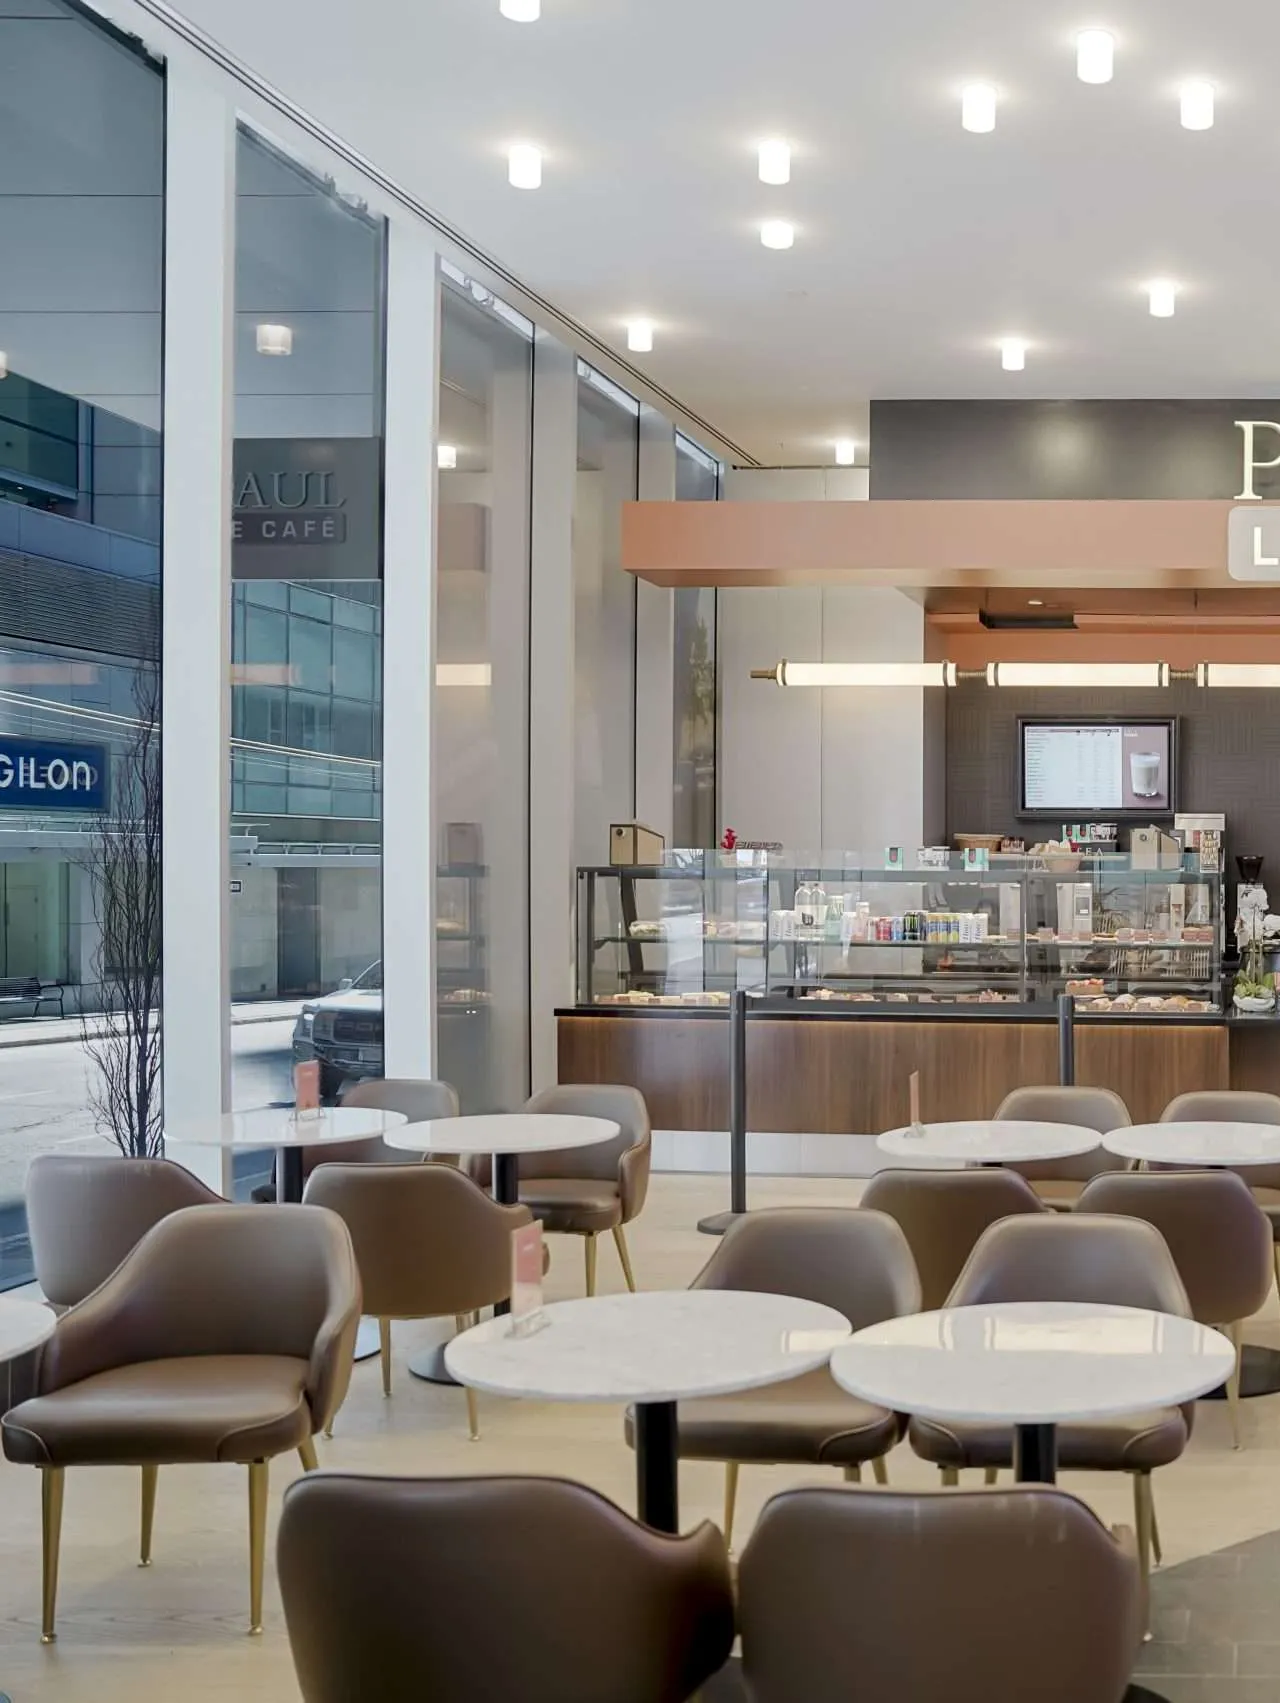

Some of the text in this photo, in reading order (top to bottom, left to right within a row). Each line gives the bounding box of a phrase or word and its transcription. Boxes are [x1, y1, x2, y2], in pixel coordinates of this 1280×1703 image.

[233, 471, 348, 509] AUL
[232, 516, 335, 538] E CAFÉ
